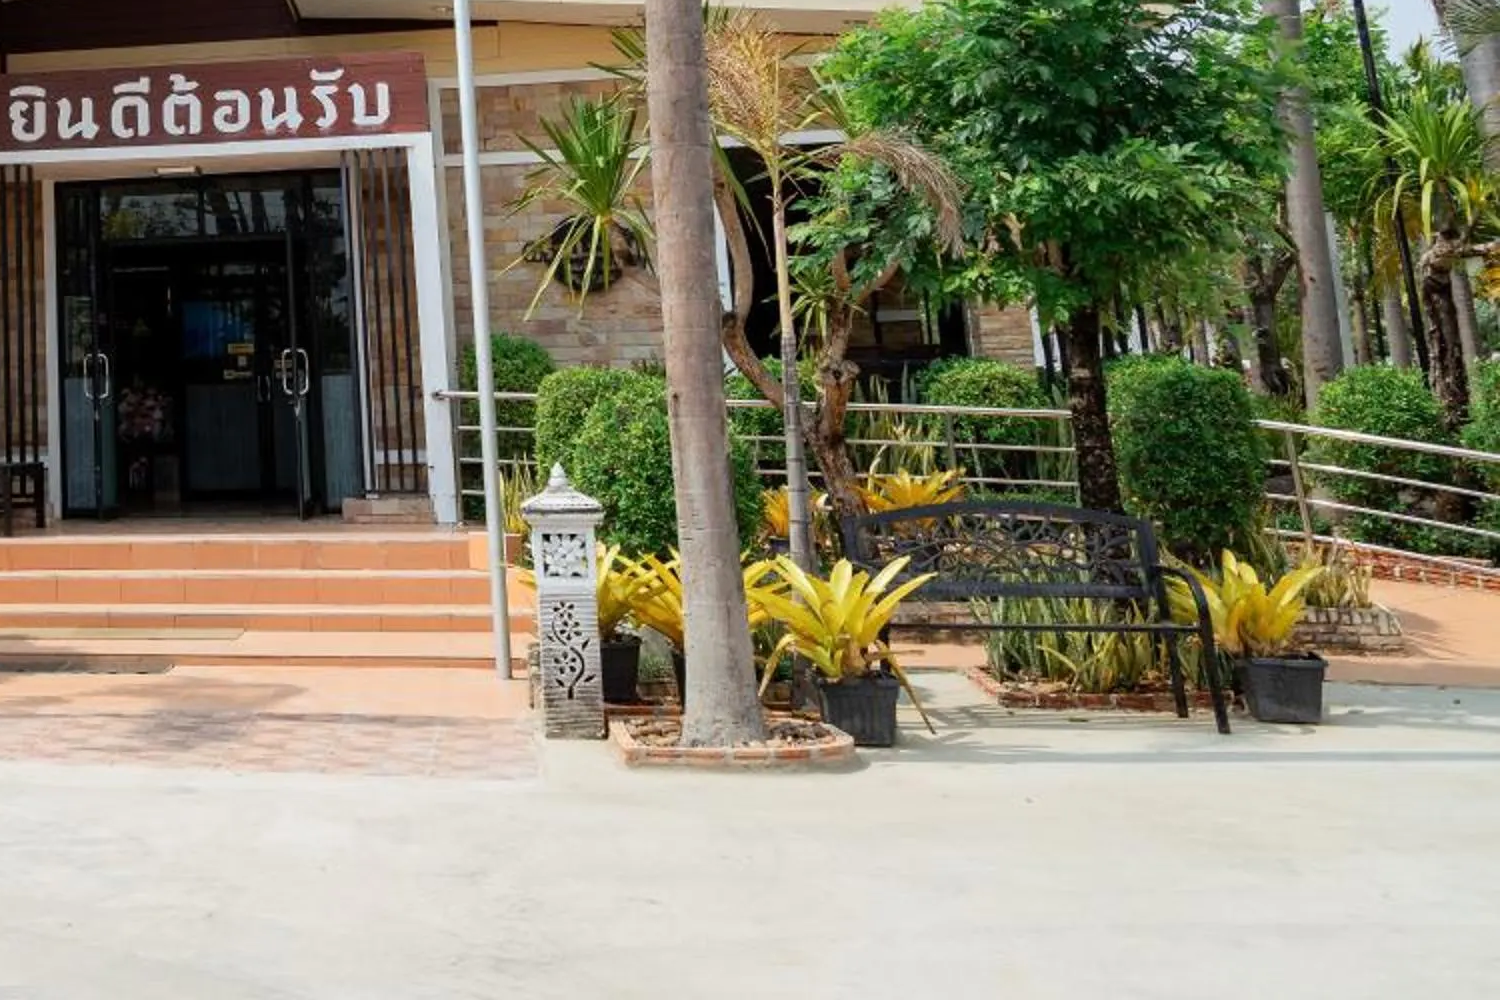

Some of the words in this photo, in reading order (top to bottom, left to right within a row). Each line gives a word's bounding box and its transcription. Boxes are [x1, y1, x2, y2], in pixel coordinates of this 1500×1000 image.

[8, 67, 391, 142] ยินดีต้อนรับ
